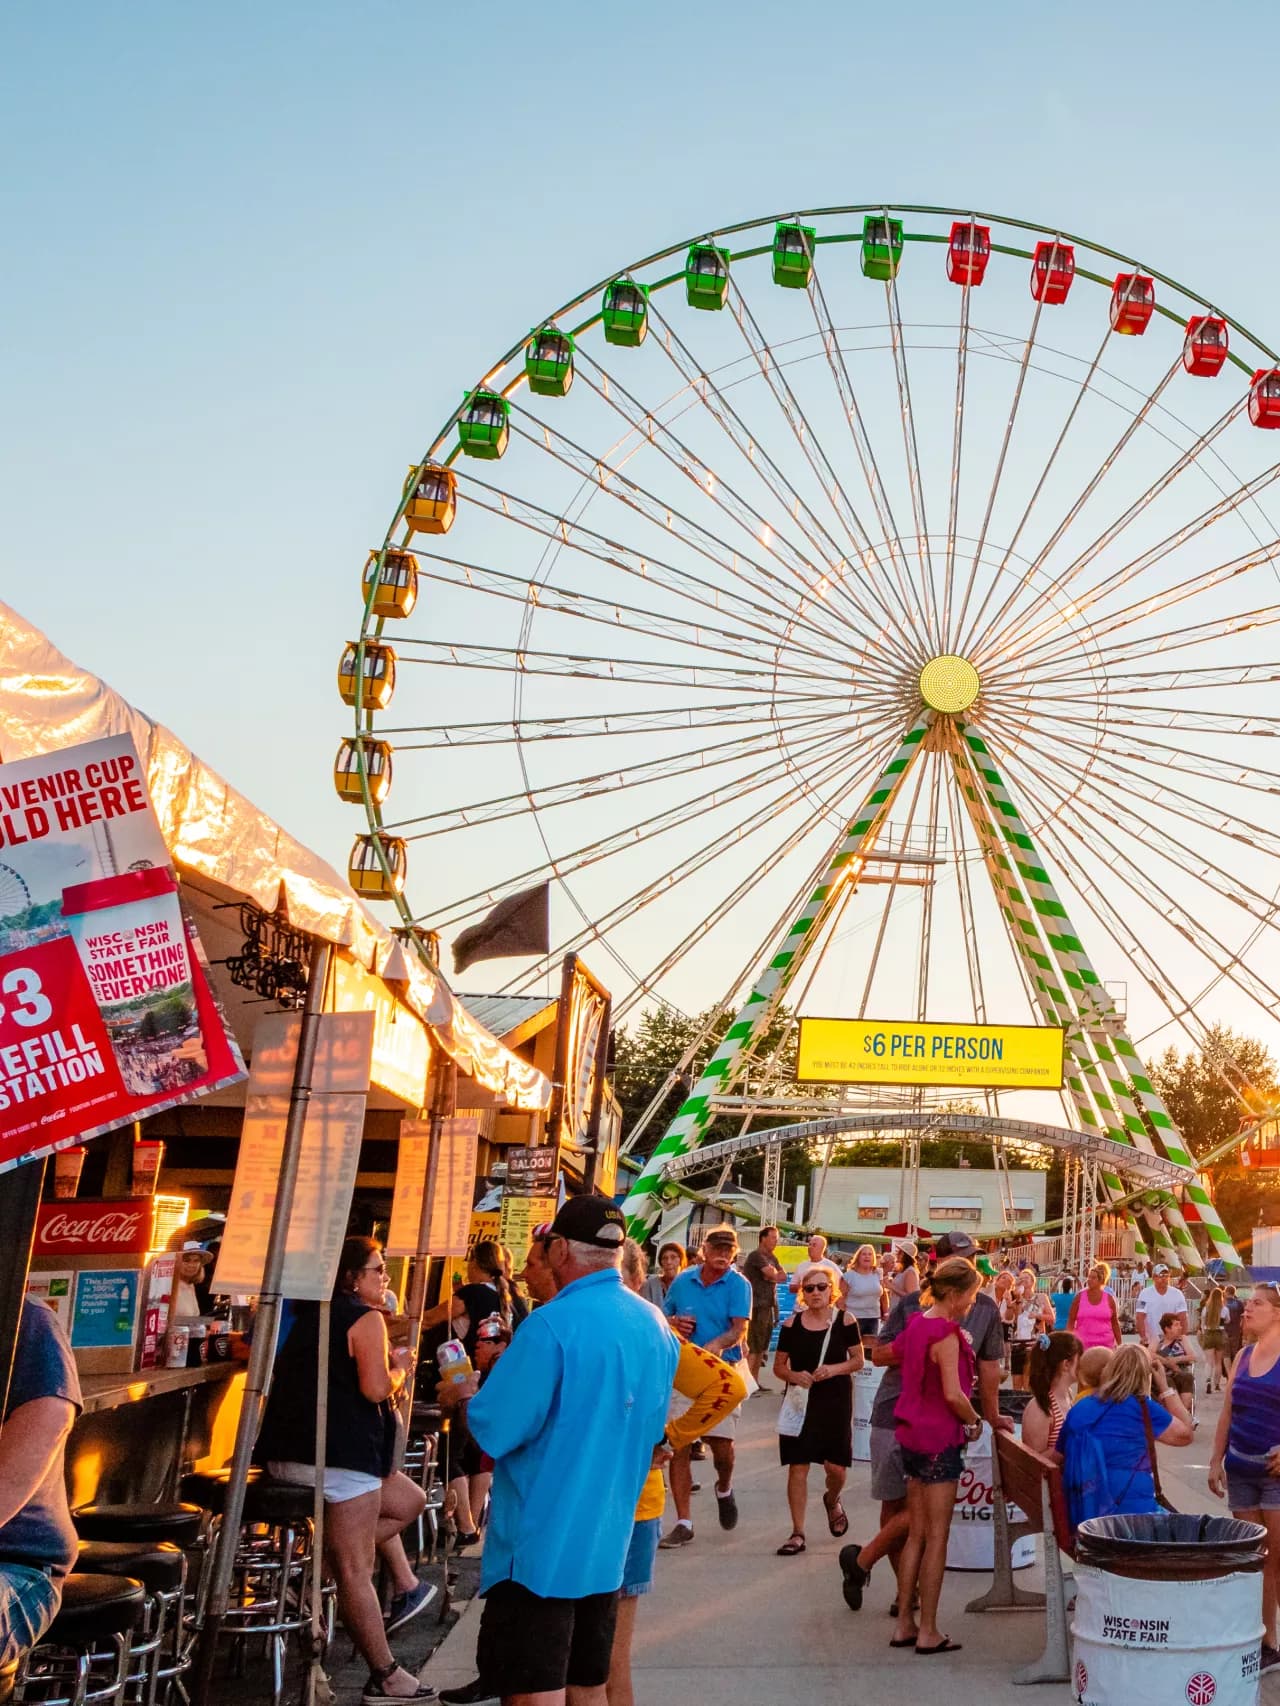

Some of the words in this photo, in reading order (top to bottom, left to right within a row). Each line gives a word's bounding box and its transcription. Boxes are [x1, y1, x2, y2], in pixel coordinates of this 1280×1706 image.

[0, 769, 83, 812] VENIR
[85, 755, 135, 788] CUP
[54, 779, 147, 831] HERE
[90, 942, 135, 960] STATE
[138, 933, 170, 949] FAIR
[88, 943, 185, 982] SOMETHING
[864, 1033, 886, 1057] $6
[891, 1034, 926, 1057] PER
[931, 1036, 1004, 1060] PERSON
[511, 1157, 552, 1170] SALOON
[41, 1212, 143, 1243] Coca-Cola
[961, 1504, 1016, 1521] LIGT
[1102, 1627, 1136, 1642] STATE
[1140, 1631, 1168, 1643] FAIR
[1103, 1614, 1170, 1631] WISCONSIN
